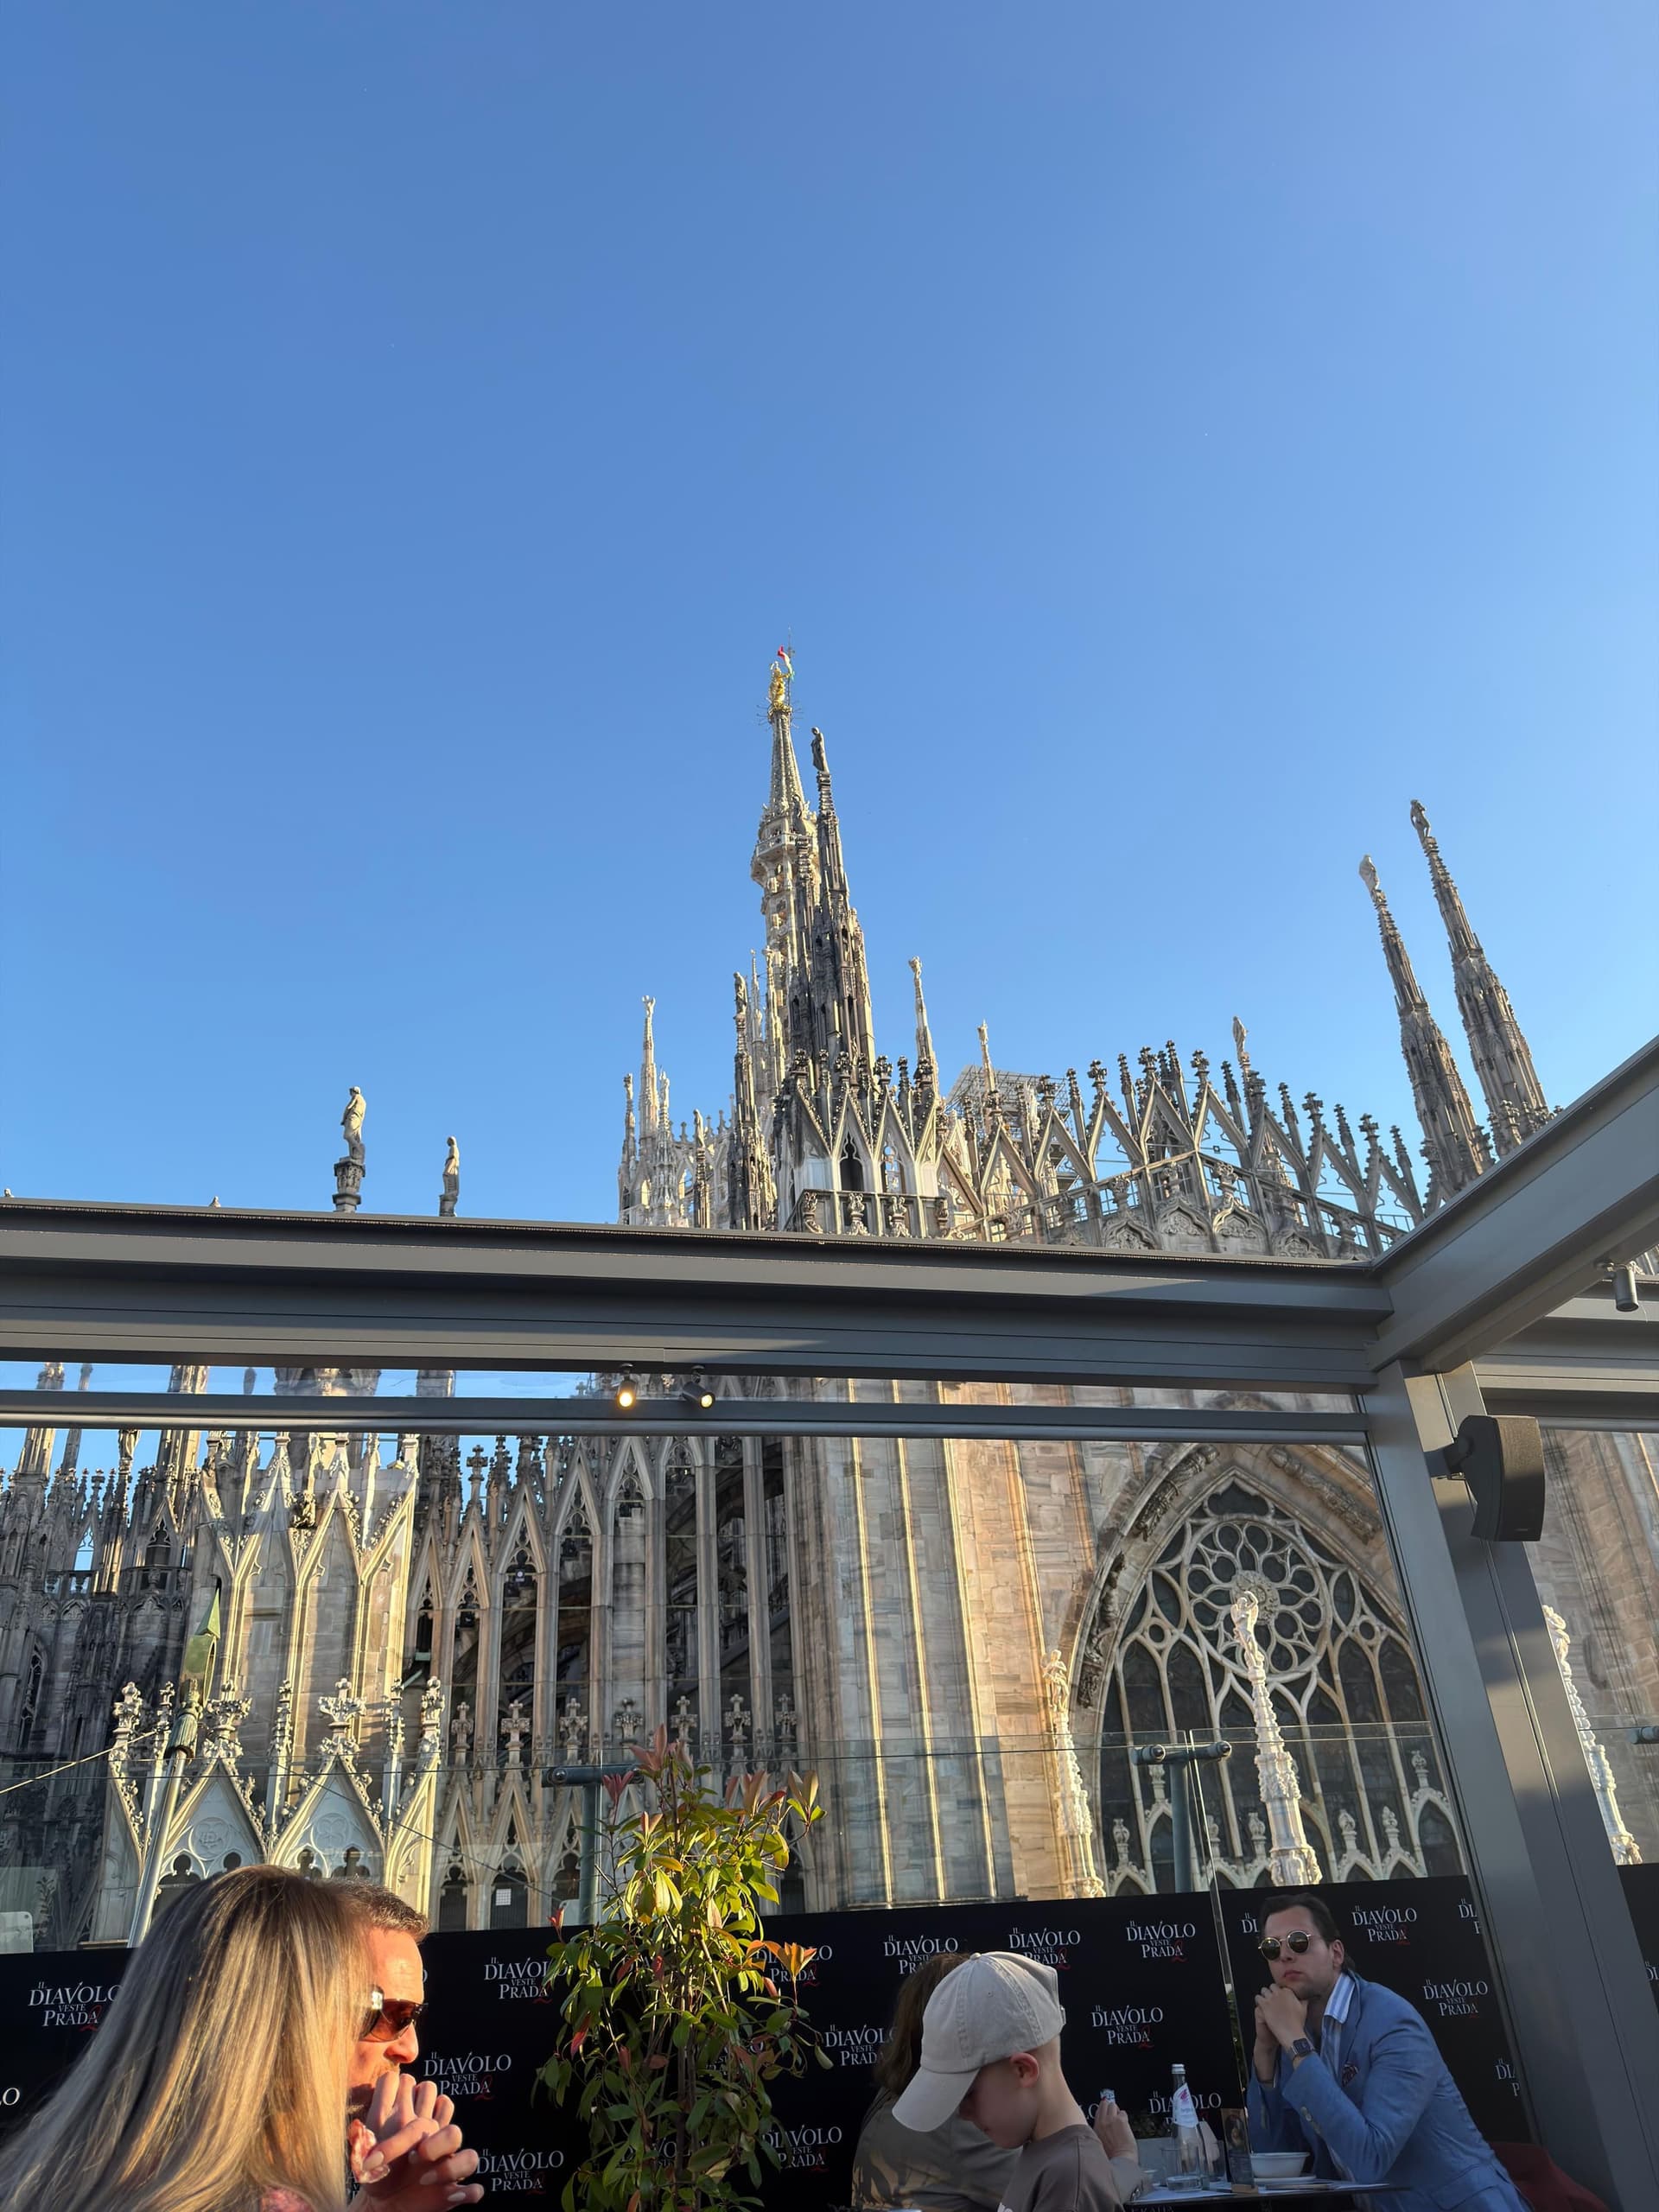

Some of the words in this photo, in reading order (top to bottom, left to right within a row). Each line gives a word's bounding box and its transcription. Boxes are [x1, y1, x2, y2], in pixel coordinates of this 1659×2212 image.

[1352, 1906, 1417, 1925] DIAVOLO
[1009, 1927, 1080, 1948] DIAVOLO
[1127, 1921, 1196, 1942] DIAVOLO
[1368, 1929, 1408, 1942] PRADA
[883, 1935, 958, 1956] DIAVOLO
[1141, 1944, 1183, 1958] PRADA
[511, 1978, 537, 1986] VESTE
[1423, 1979, 1488, 1999] DIAVOLO
[499, 1984, 548, 1999] PRADA
[58, 2003, 86, 2012] VESTE
[1439, 2003, 1478, 2016] PRADA
[42, 2010, 99, 2027] PRADA
[1091, 2005, 1163, 2027] DIAVOLO
[1107, 2031, 1150, 2045] PRADA
[851, 2044, 874, 2053] VESTE
[424, 2051, 512, 2076] DIAVOLO
[452, 2074, 477, 2082] VESTE
[440, 2080, 491, 2095] PRADA
[483, 2148, 492, 2157] IL
[476, 2148, 564, 2174] DIAVOLO
[504, 2171, 531, 2180] VESTE
[490, 2177, 543, 2192] PRADA
